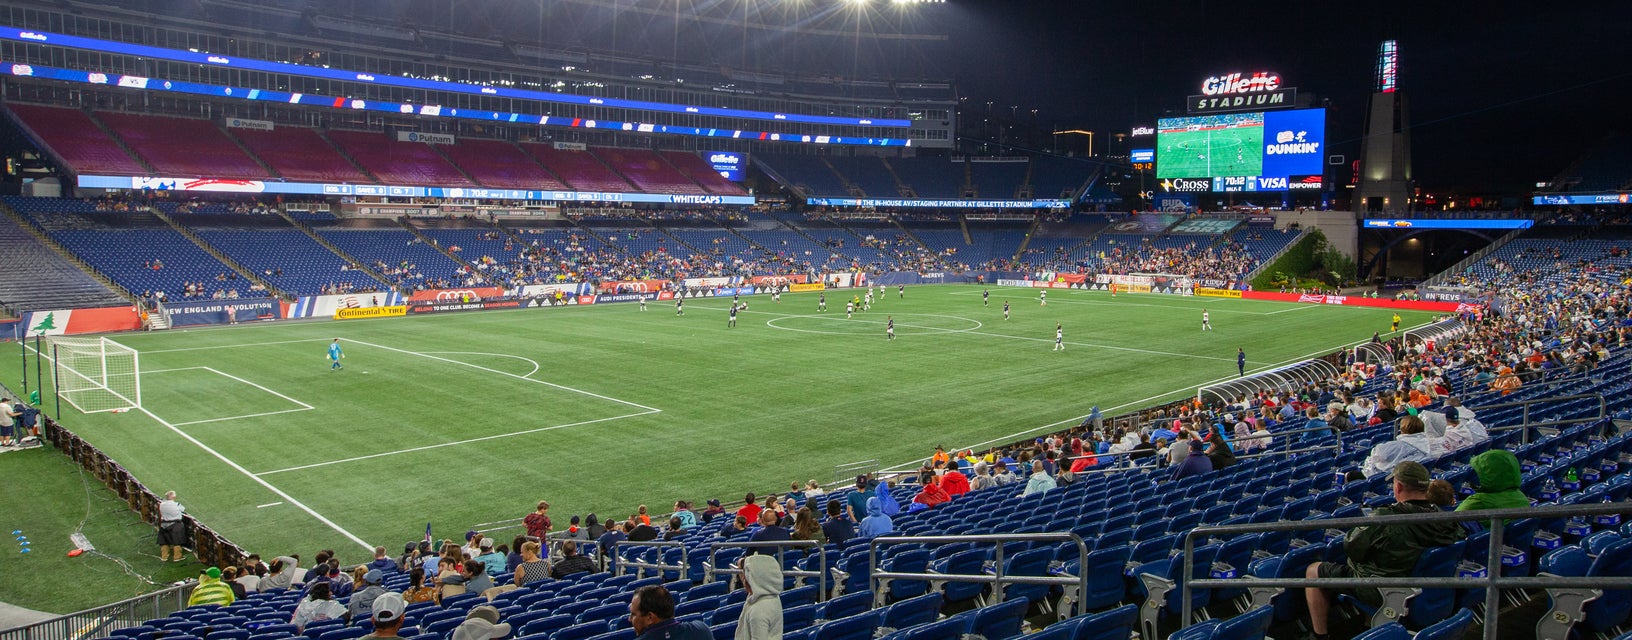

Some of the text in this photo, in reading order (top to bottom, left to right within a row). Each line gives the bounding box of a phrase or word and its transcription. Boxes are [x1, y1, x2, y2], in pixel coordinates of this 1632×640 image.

[1201, 71, 1281, 96] Gillette
[1198, 92, 1284, 109] STADIUM
[1132, 127, 1154, 137] jetBlue
[419, 134, 451, 144] Putnam
[1266, 142, 1320, 155] DUNKIN'
[1225, 176, 1246, 186] 70:12
[1258, 178, 1288, 189] VISA
[672, 195, 720, 204] WHITECAPS
[185, 306, 222, 314] ENGLAND
[338, 308, 380, 318] Continental
[680, 514, 694, 526] 22
